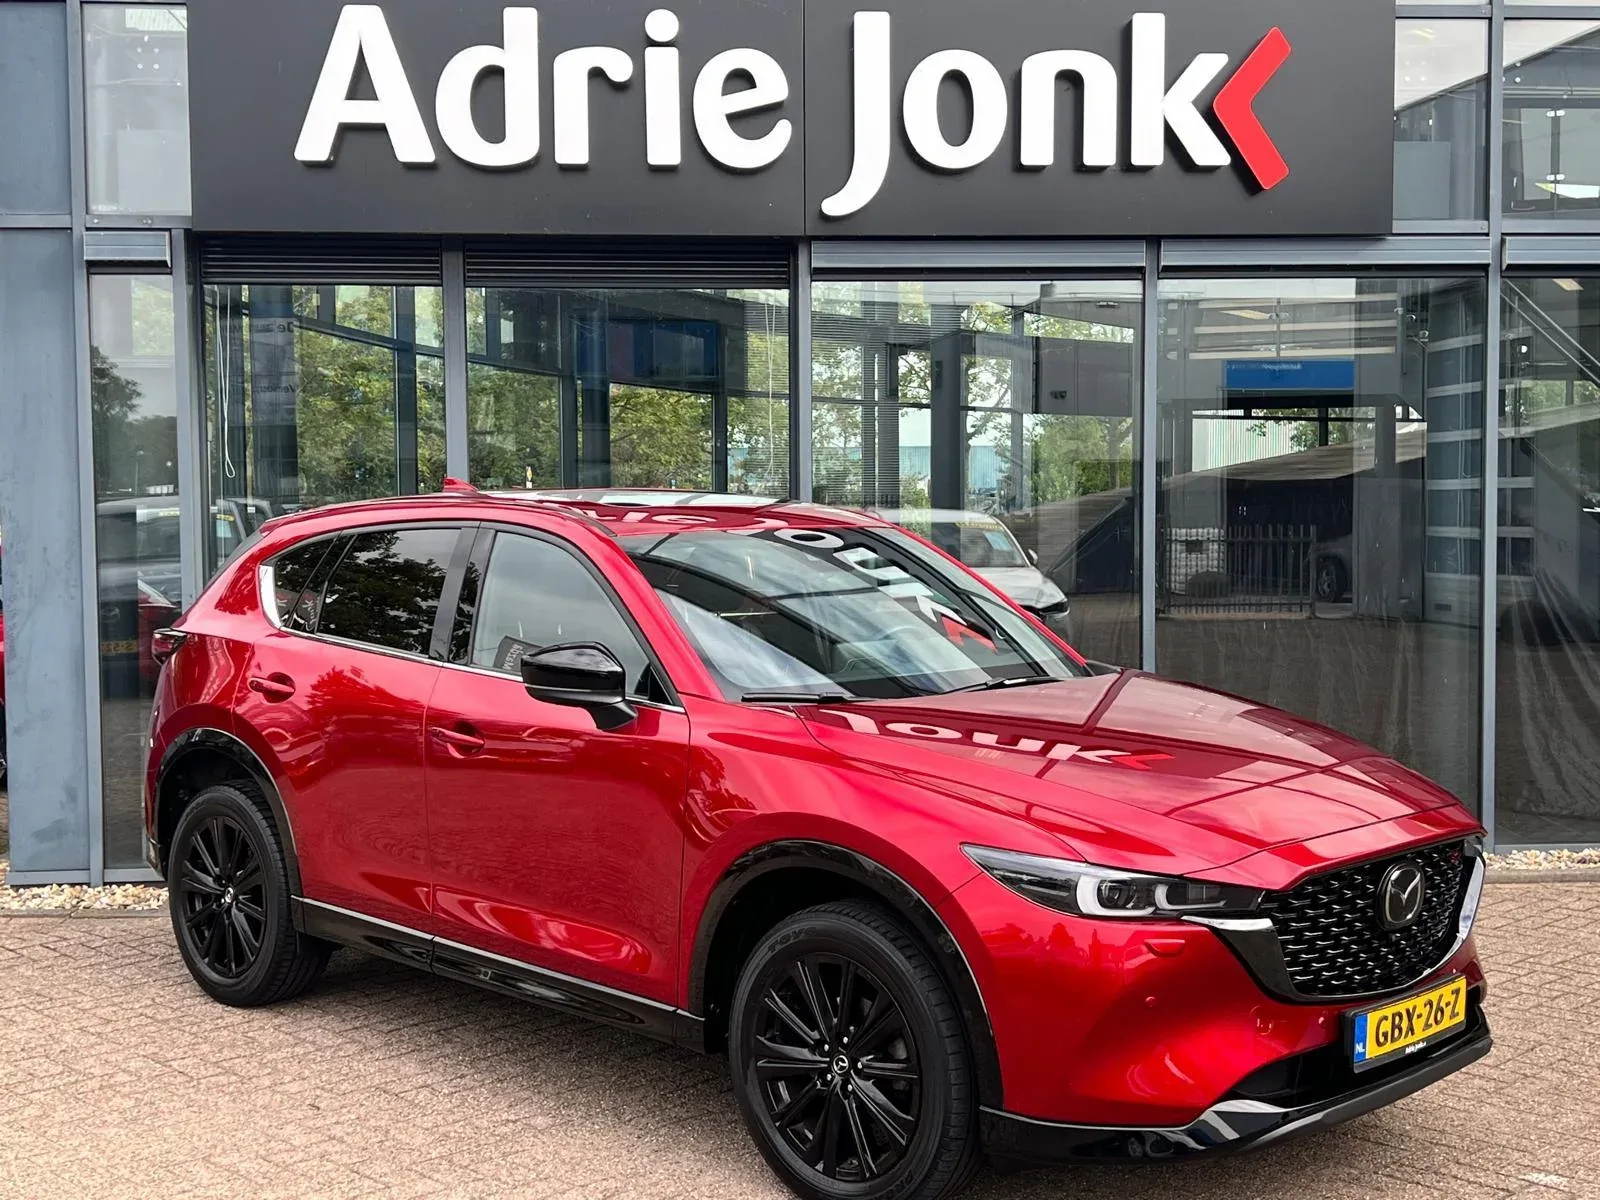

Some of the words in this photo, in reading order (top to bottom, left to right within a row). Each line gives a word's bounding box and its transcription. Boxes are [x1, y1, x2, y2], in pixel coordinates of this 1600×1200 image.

[294, 4, 792, 170] Adrie
[820, 11, 1231, 217] Jonk
[1355, 1043, 1365, 1054] NL
[1375, 986, 1461, 1048] GBX-26-Z
